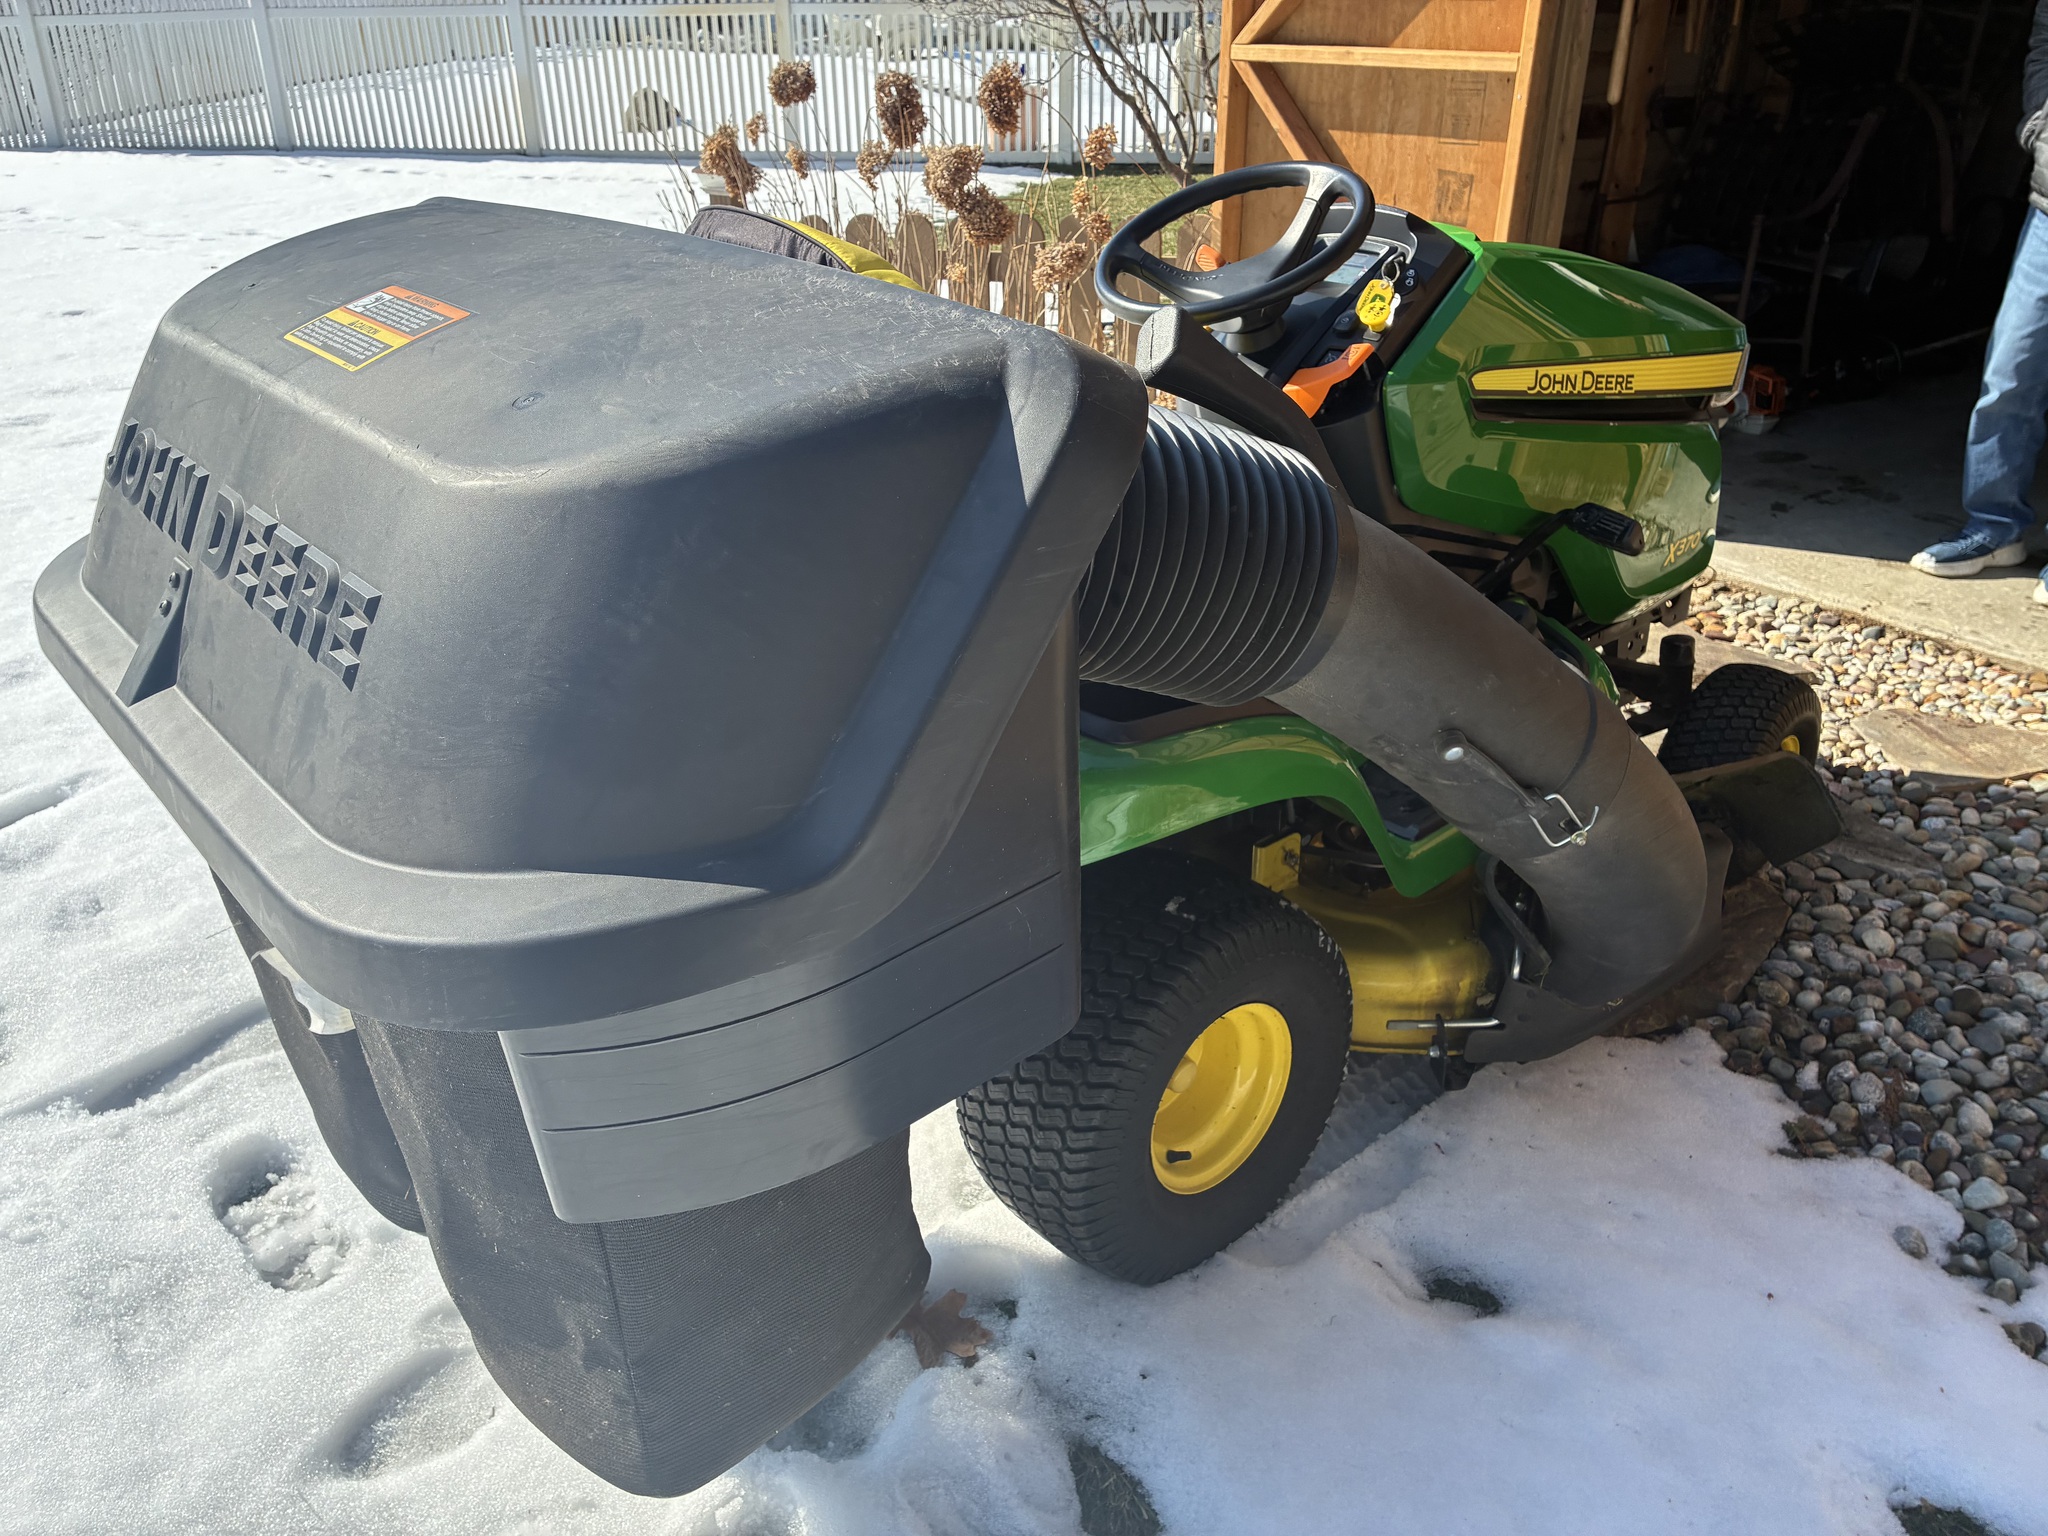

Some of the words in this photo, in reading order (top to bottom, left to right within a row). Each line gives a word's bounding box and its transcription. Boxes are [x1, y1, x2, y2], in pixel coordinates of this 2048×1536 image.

[355, 321, 381, 336] CAUTION
[1527, 369, 1578, 392] JOHN
[1581, 370, 1635, 392] DEERE
[104, 417, 210, 553] JOHN
[201, 485, 382, 692] DEERE
[1663, 531, 1702, 568] X370
